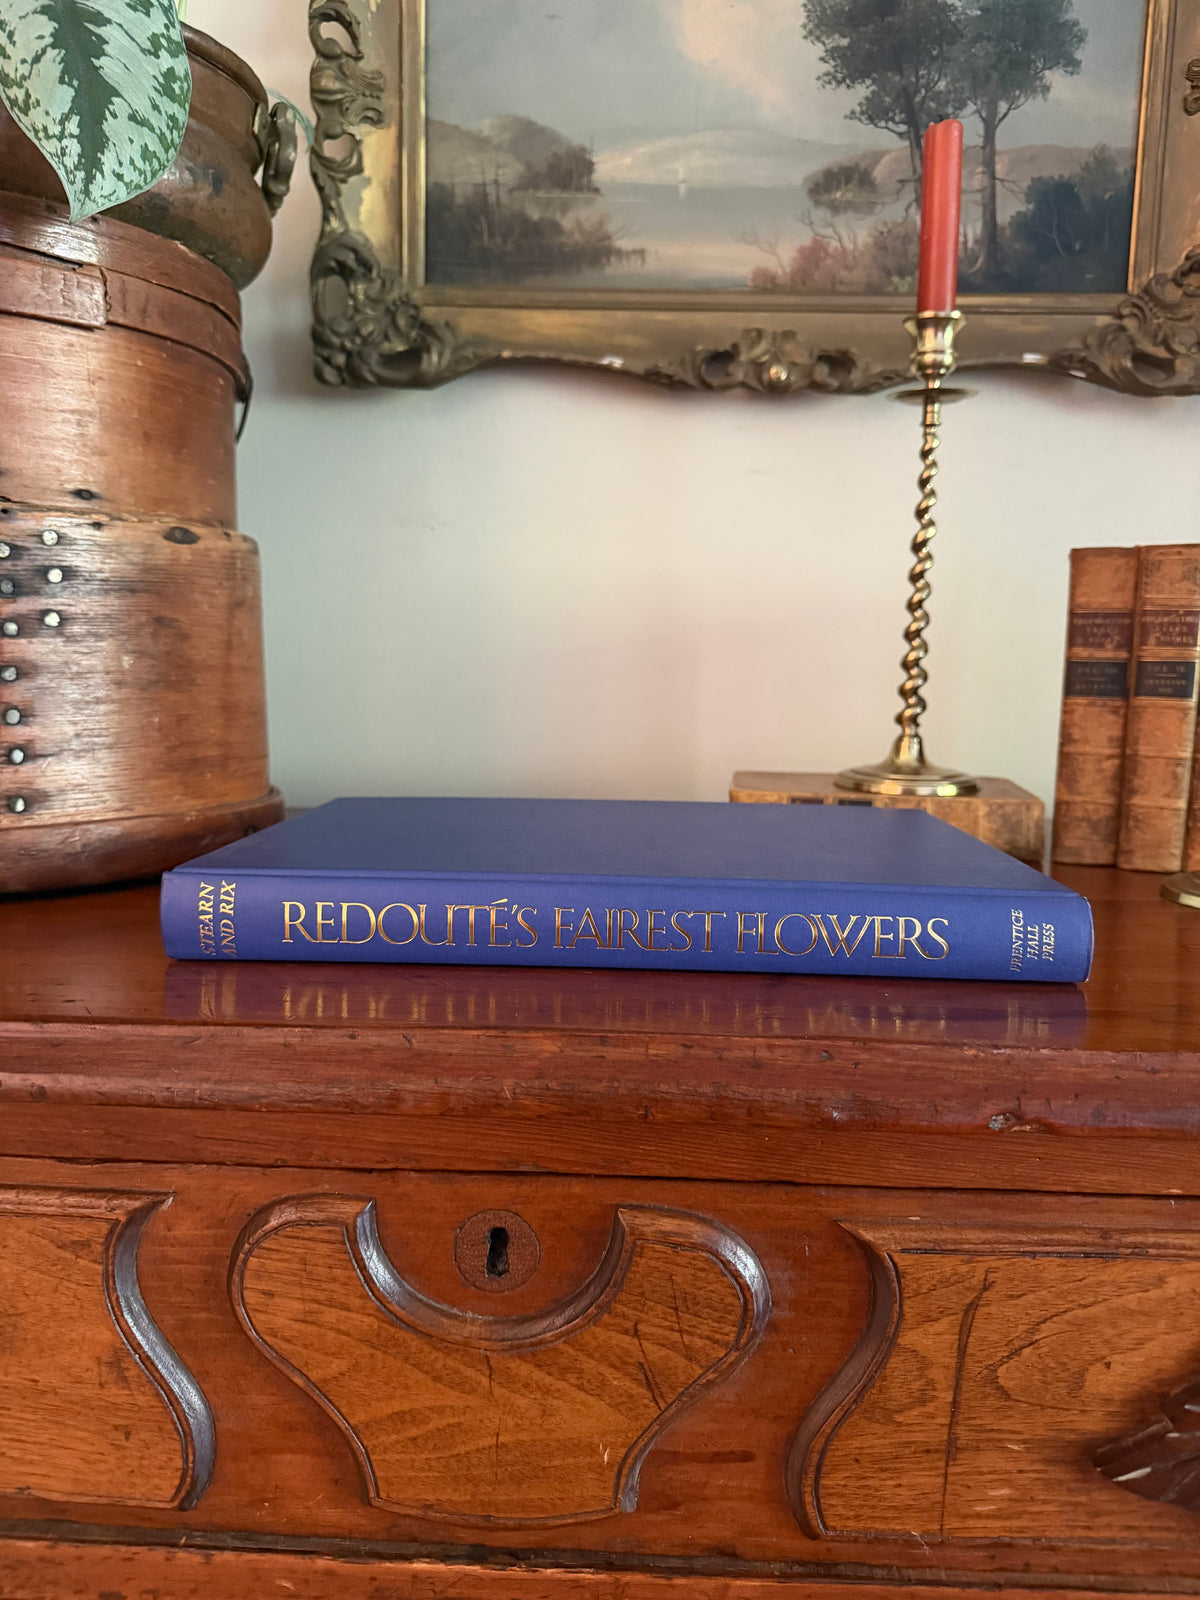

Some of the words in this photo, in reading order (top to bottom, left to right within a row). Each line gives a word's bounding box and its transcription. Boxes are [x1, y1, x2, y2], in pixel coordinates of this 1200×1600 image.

[219, 880, 236, 916] RIX
[198, 881, 216, 956] STEARN
[282, 898, 538, 948] REDOUTÉ'S
[553, 907, 726, 951] FAIREST
[735, 912, 950, 960] FLOWERS
[219, 919, 238, 958] AND
[1010, 909, 1023, 972] PRENTICE
[1026, 924, 1039, 960] HALL
[1042, 923, 1055, 962] PRESS
